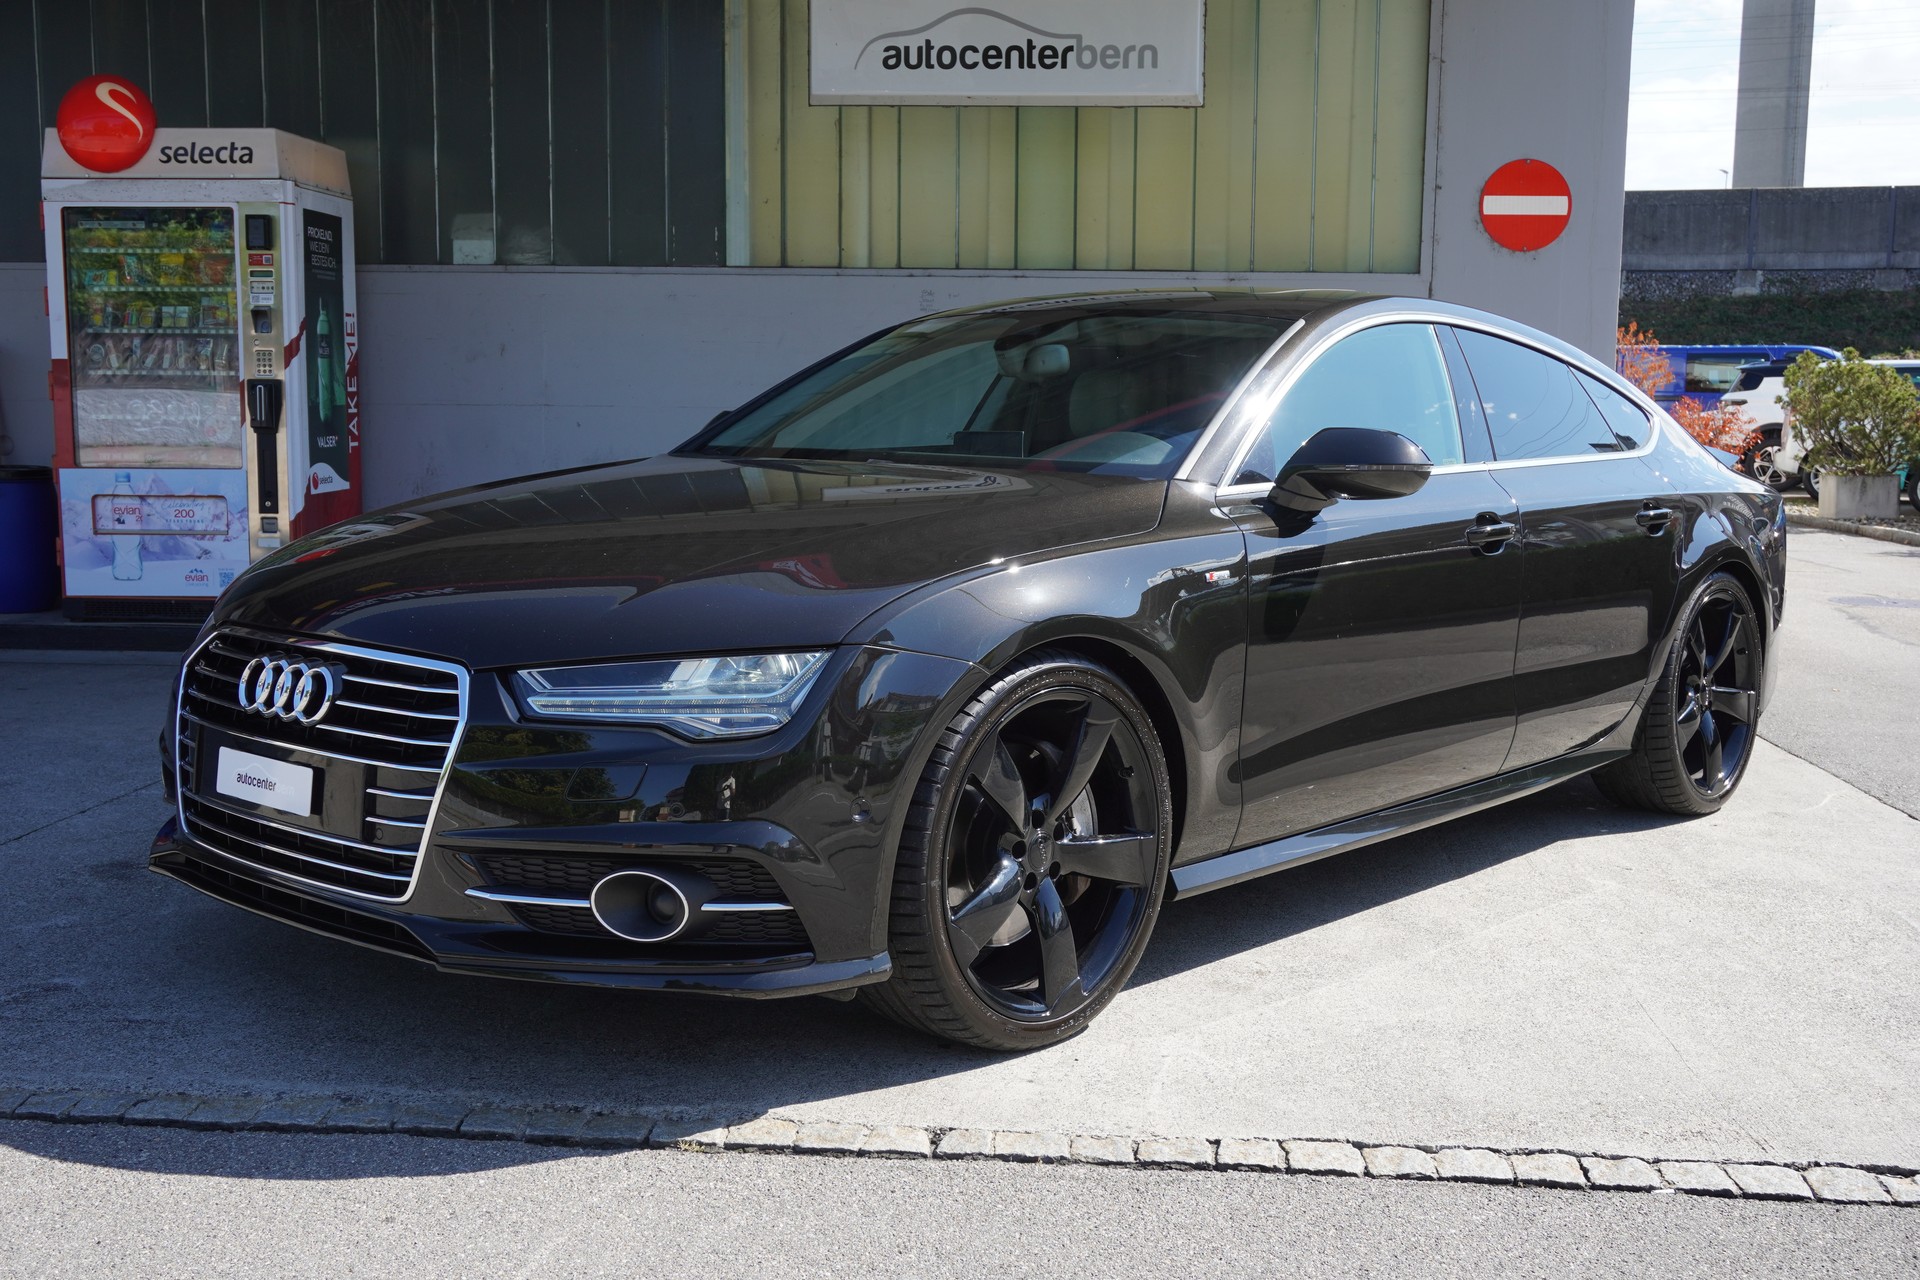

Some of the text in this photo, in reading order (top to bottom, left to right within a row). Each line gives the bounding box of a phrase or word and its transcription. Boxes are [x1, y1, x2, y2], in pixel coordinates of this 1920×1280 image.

[882, 37, 1158, 70] autocenterbern
[158, 142, 254, 164] selecta
[345, 313, 359, 453] TAKE ME!
[317, 435, 336, 448] VALSER
[319, 475, 333, 485] selecta
[113, 505, 141, 515] evian
[174, 509, 195, 519] 200
[185, 573, 208, 582] evian
